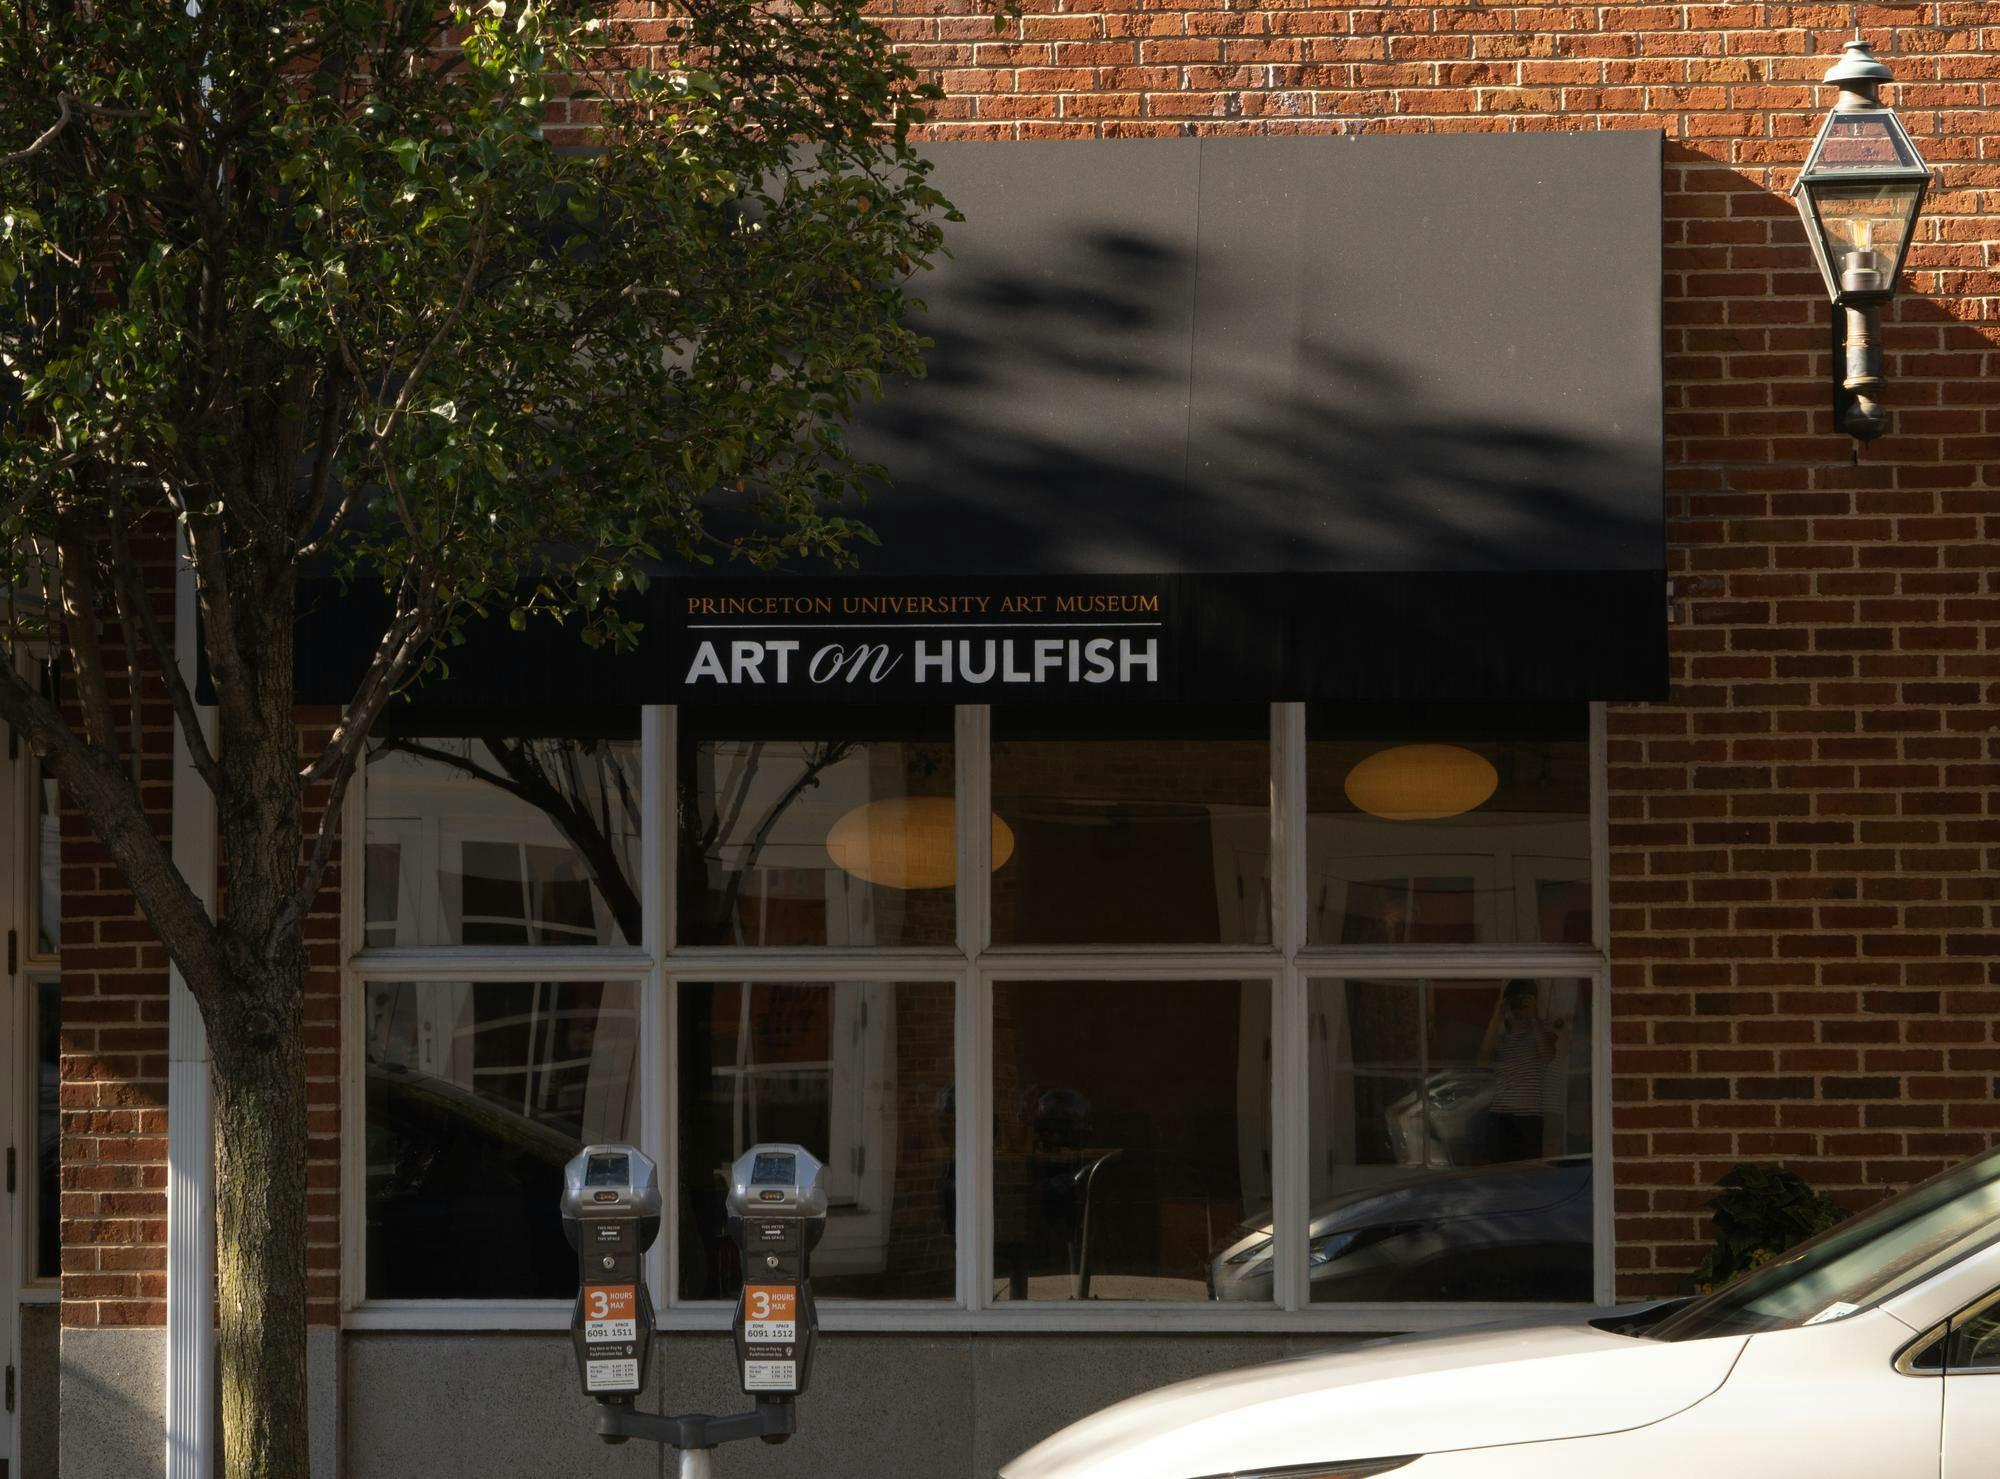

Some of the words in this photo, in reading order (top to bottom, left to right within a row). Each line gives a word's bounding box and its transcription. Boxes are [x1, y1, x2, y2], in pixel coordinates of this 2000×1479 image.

[687, 597, 832, 615] PRINCETON
[842, 596, 991, 614] UNIVERSITY
[1000, 595, 1047, 613] ART
[1056, 594, 1160, 612] MUSEUM
[684, 640, 800, 685] ART
[808, 643, 904, 684] on
[914, 638, 1159, 684] HULFISH
[591, 1291, 609, 1319] 3
[610, 1292, 633, 1300] HOURS
[752, 1291, 770, 1319] 3
[771, 1293, 795, 1301] HOURS
[587, 1329, 609, 1337] 6091
[612, 1328, 632, 1336] 1511
